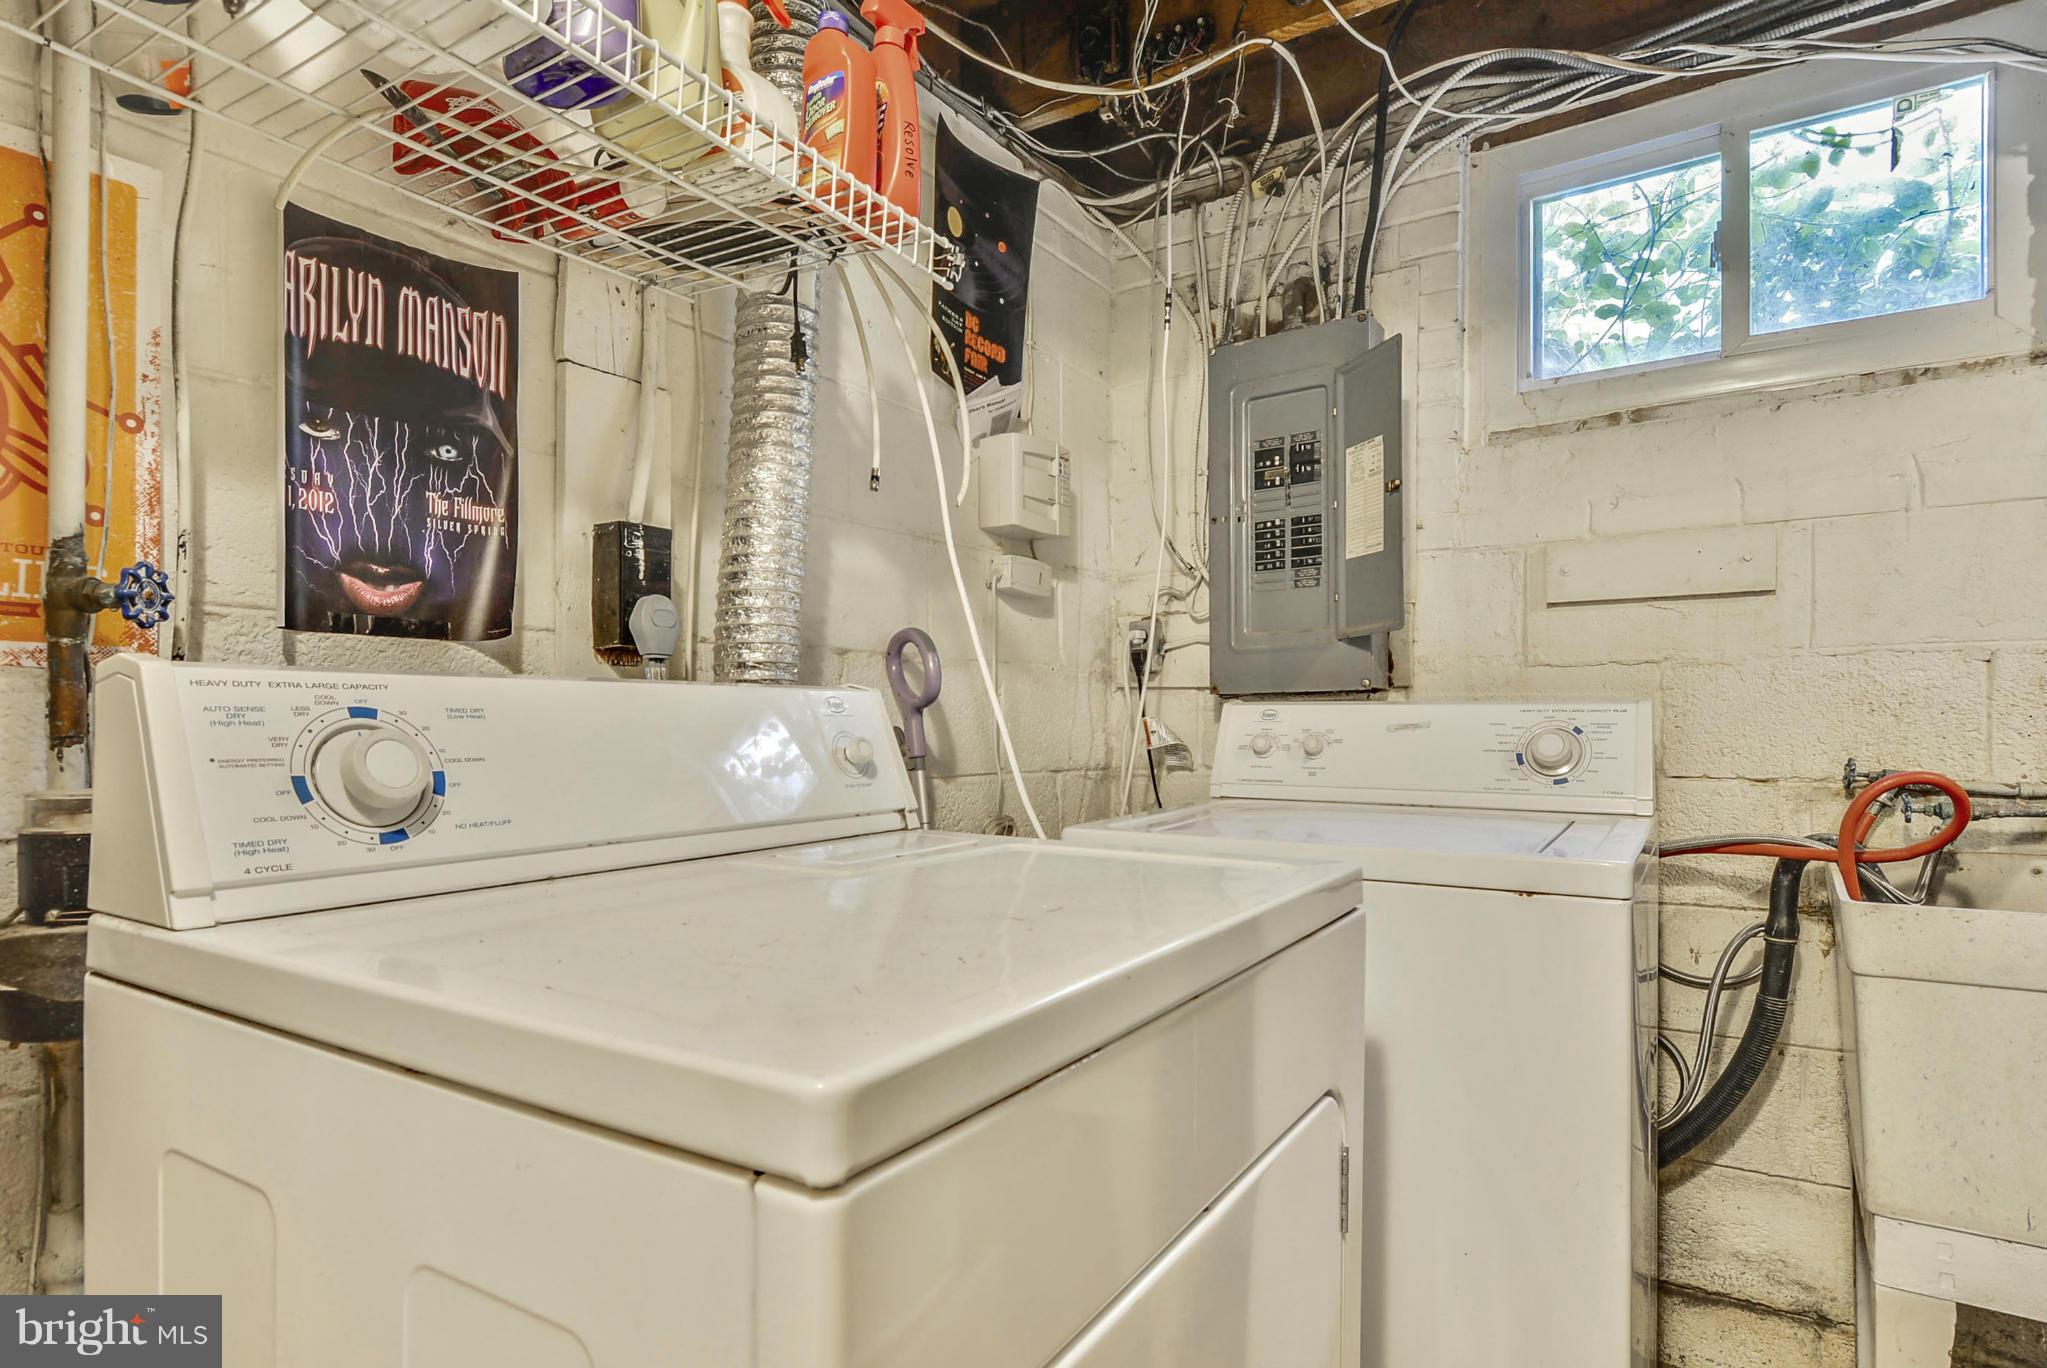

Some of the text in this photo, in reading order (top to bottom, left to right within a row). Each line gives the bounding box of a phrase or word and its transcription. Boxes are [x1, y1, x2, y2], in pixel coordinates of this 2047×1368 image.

[903, 120, 918, 178] Resolve
[285, 250, 507, 400] ARILYN MANSON
[291, 467, 334, 488] SDAY
[298, 488, 335, 514] 2012
[426, 491, 505, 526] The Fillmore
[426, 517, 505, 537] SILVER SPRING
[1, 542, 45, 556] TOU
[189, 679, 389, 691] HEAVY DUTY EXTRA LARGE CAPACITY
[202, 705, 266, 713] AUTO SENSE
[209, 719, 265, 728] (High Heat)
[252, 816, 279, 824] COOL
[232, 838, 288, 849] TIMED DRY
[234, 846, 290, 858] (High Heat)
[243, 863, 294, 875] 4 CYCLE
